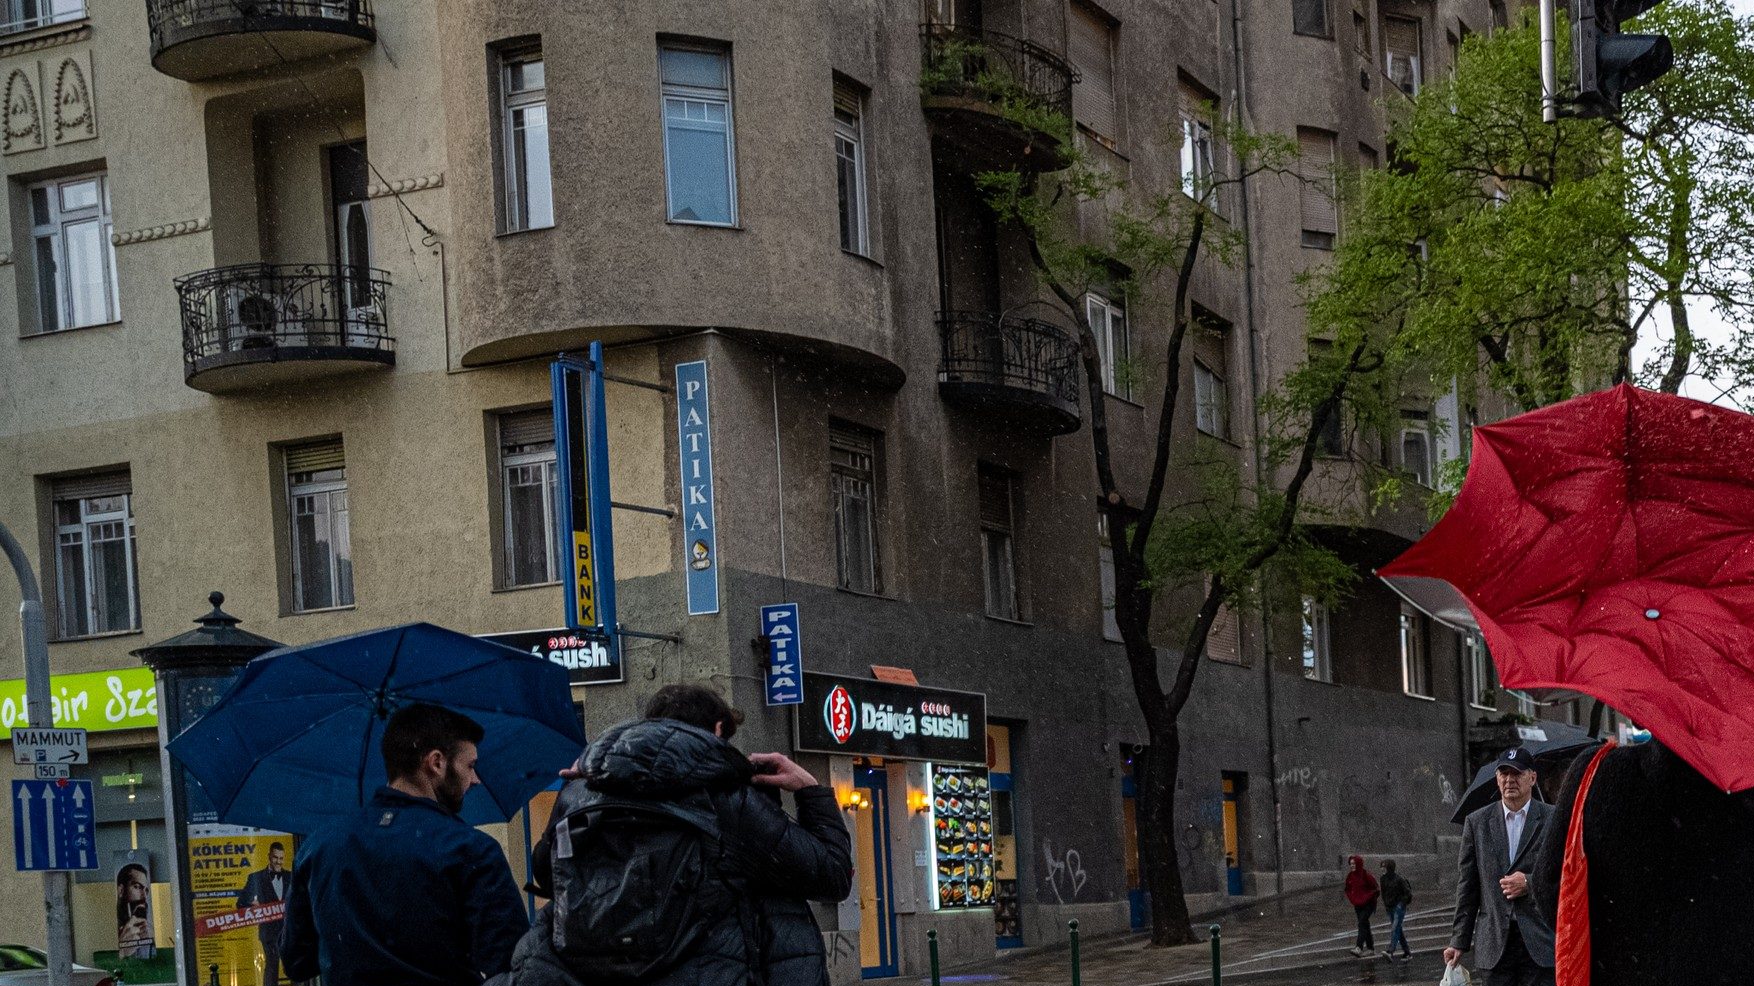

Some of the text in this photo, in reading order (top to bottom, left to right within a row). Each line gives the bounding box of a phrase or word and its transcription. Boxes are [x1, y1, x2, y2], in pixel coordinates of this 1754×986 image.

[684, 379, 709, 531] PATIKA
[578, 543, 593, 621] BANK
[549, 640, 611, 670] sush
[768, 610, 796, 688] PATIKA
[862, 702, 917, 740] Dáigá
[921, 712, 970, 740] sushi
[16, 732, 82, 746] MAMMUT
[39, 766, 68, 777] 150 m
[193, 841, 256, 857] KÖKÉNY
[194, 857, 251, 870] ATTILA
